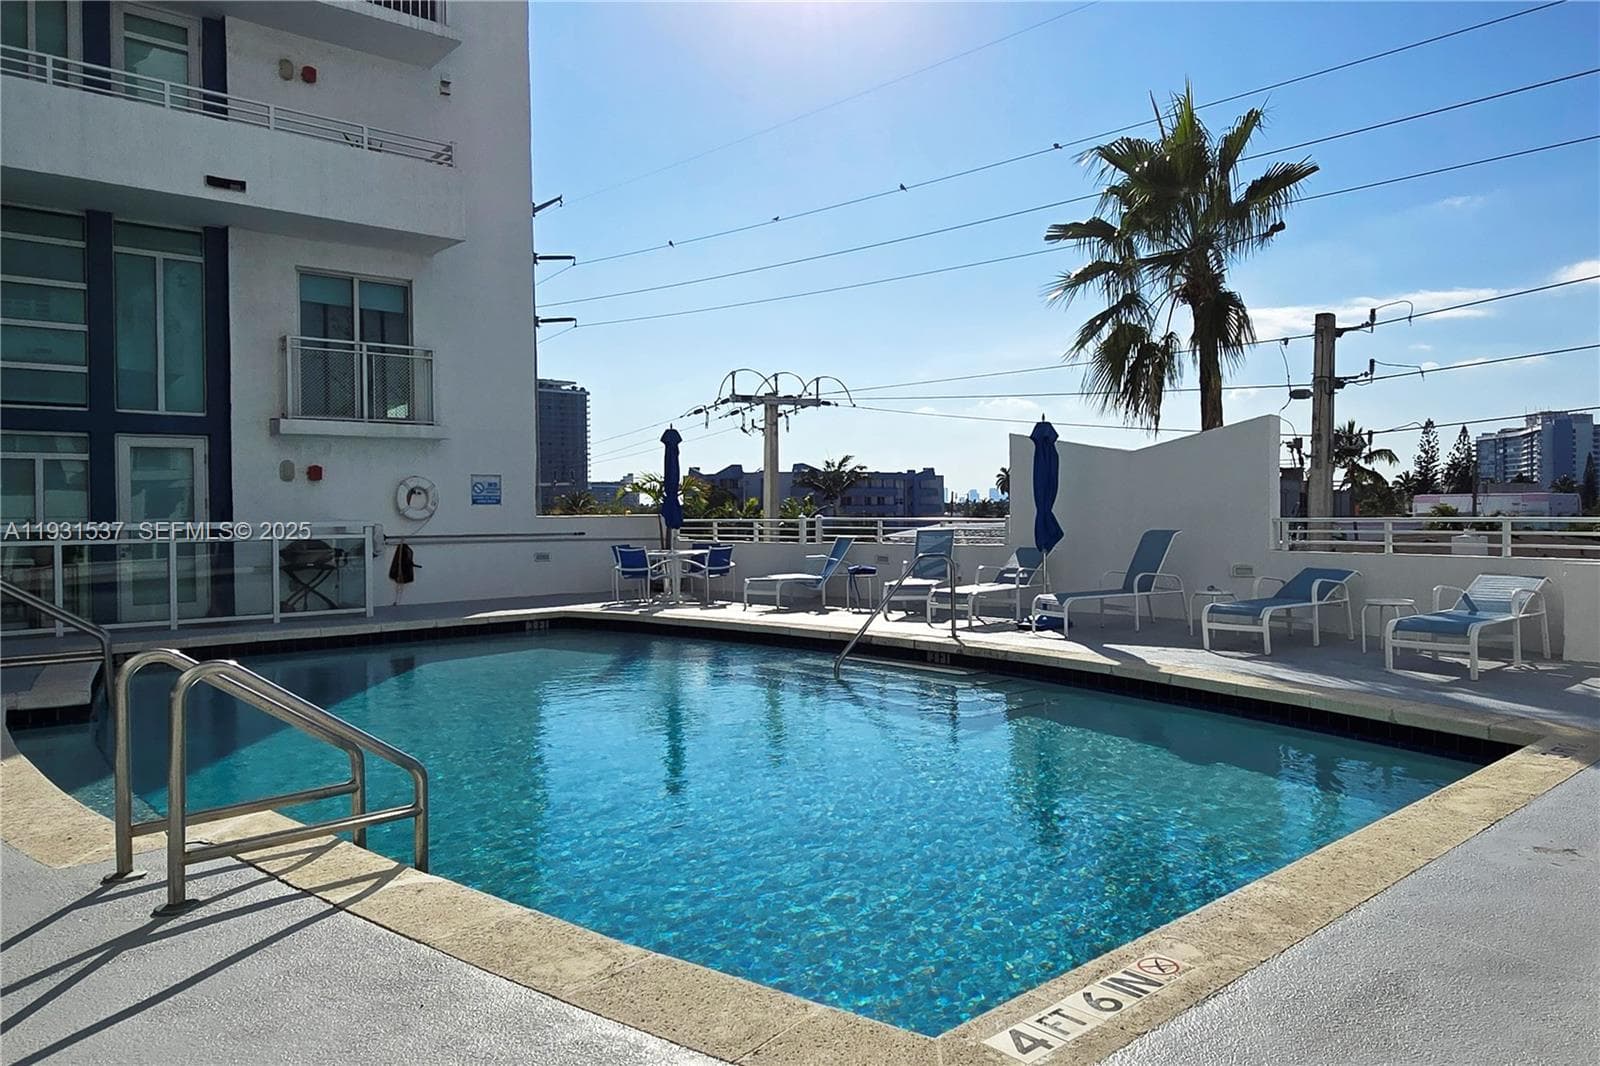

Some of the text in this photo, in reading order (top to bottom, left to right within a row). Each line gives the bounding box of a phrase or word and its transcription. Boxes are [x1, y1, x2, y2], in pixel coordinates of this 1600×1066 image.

[1100, 970, 1165, 999] IN
[1083, 992, 1124, 1012] 6
[1036, 1008, 1088, 1036] FT
[1009, 1028, 1055, 1055] 4
